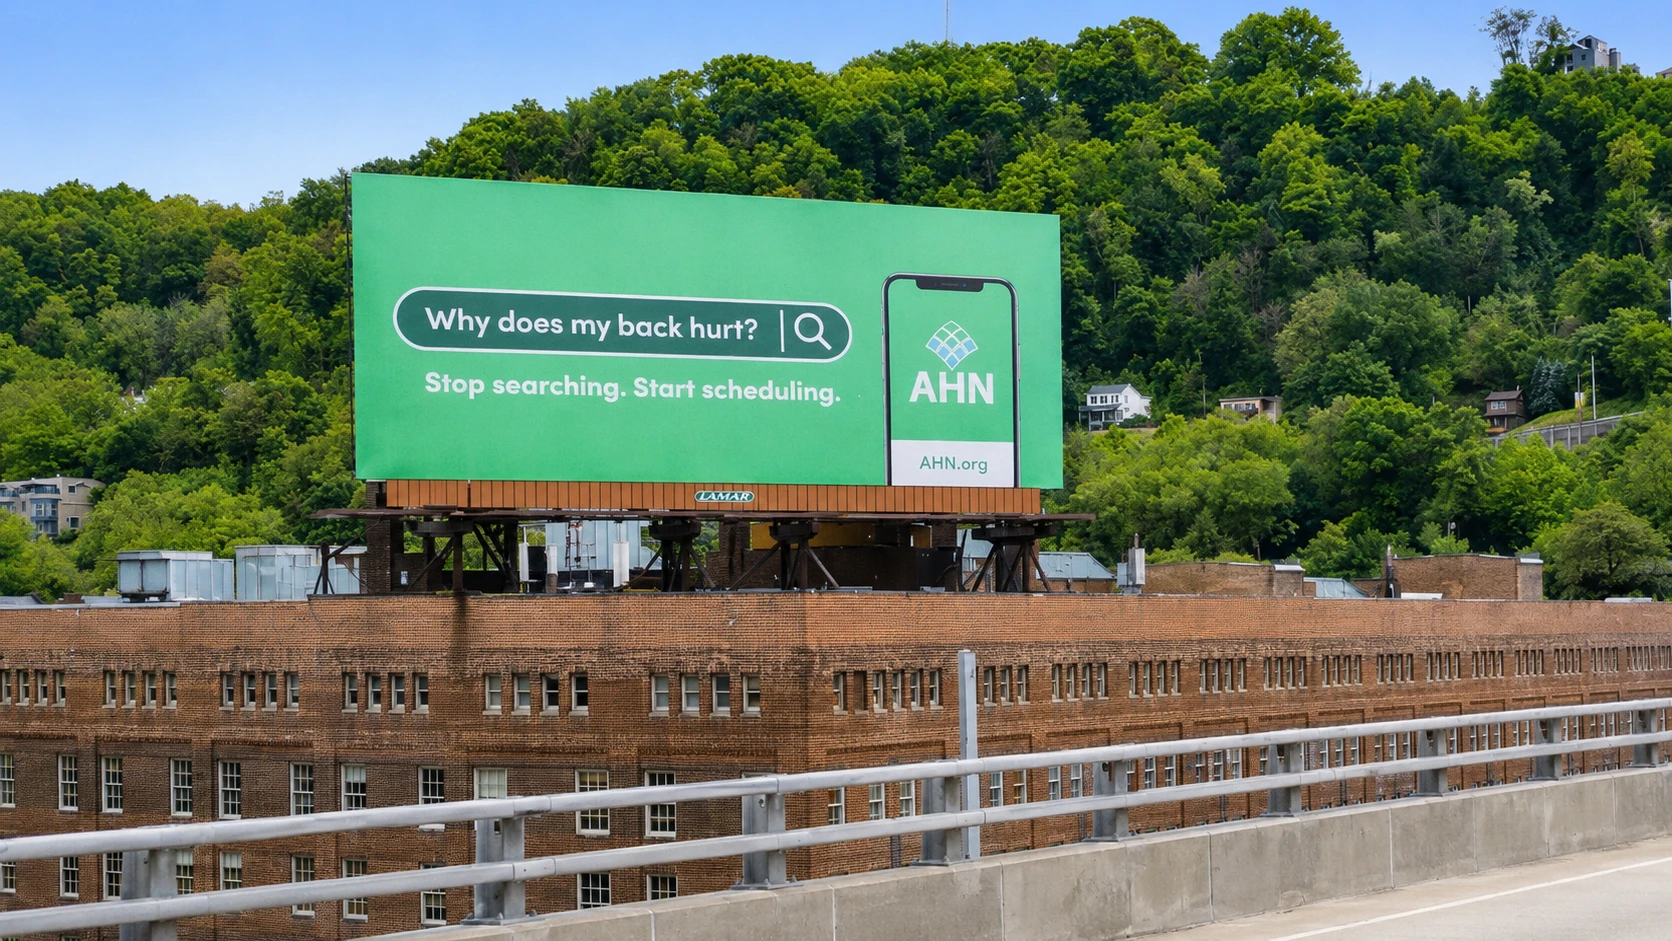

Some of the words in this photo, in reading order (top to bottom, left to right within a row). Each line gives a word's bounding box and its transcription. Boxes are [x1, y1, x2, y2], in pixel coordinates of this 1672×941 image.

[424, 307, 491, 338] Why
[498, 309, 564, 335] does
[571, 318, 611, 342] my
[618, 313, 684, 338] back
[690, 315, 758, 341] hurt?
[425, 371, 485, 400] Stop
[492, 374, 627, 403] searching.
[633, 377, 696, 399] Start
[702, 378, 841, 408] scheduling.
[908, 370, 995, 405] AHN
[919, 455, 989, 475] AHN.org
[698, 492, 750, 501] LAMAR
